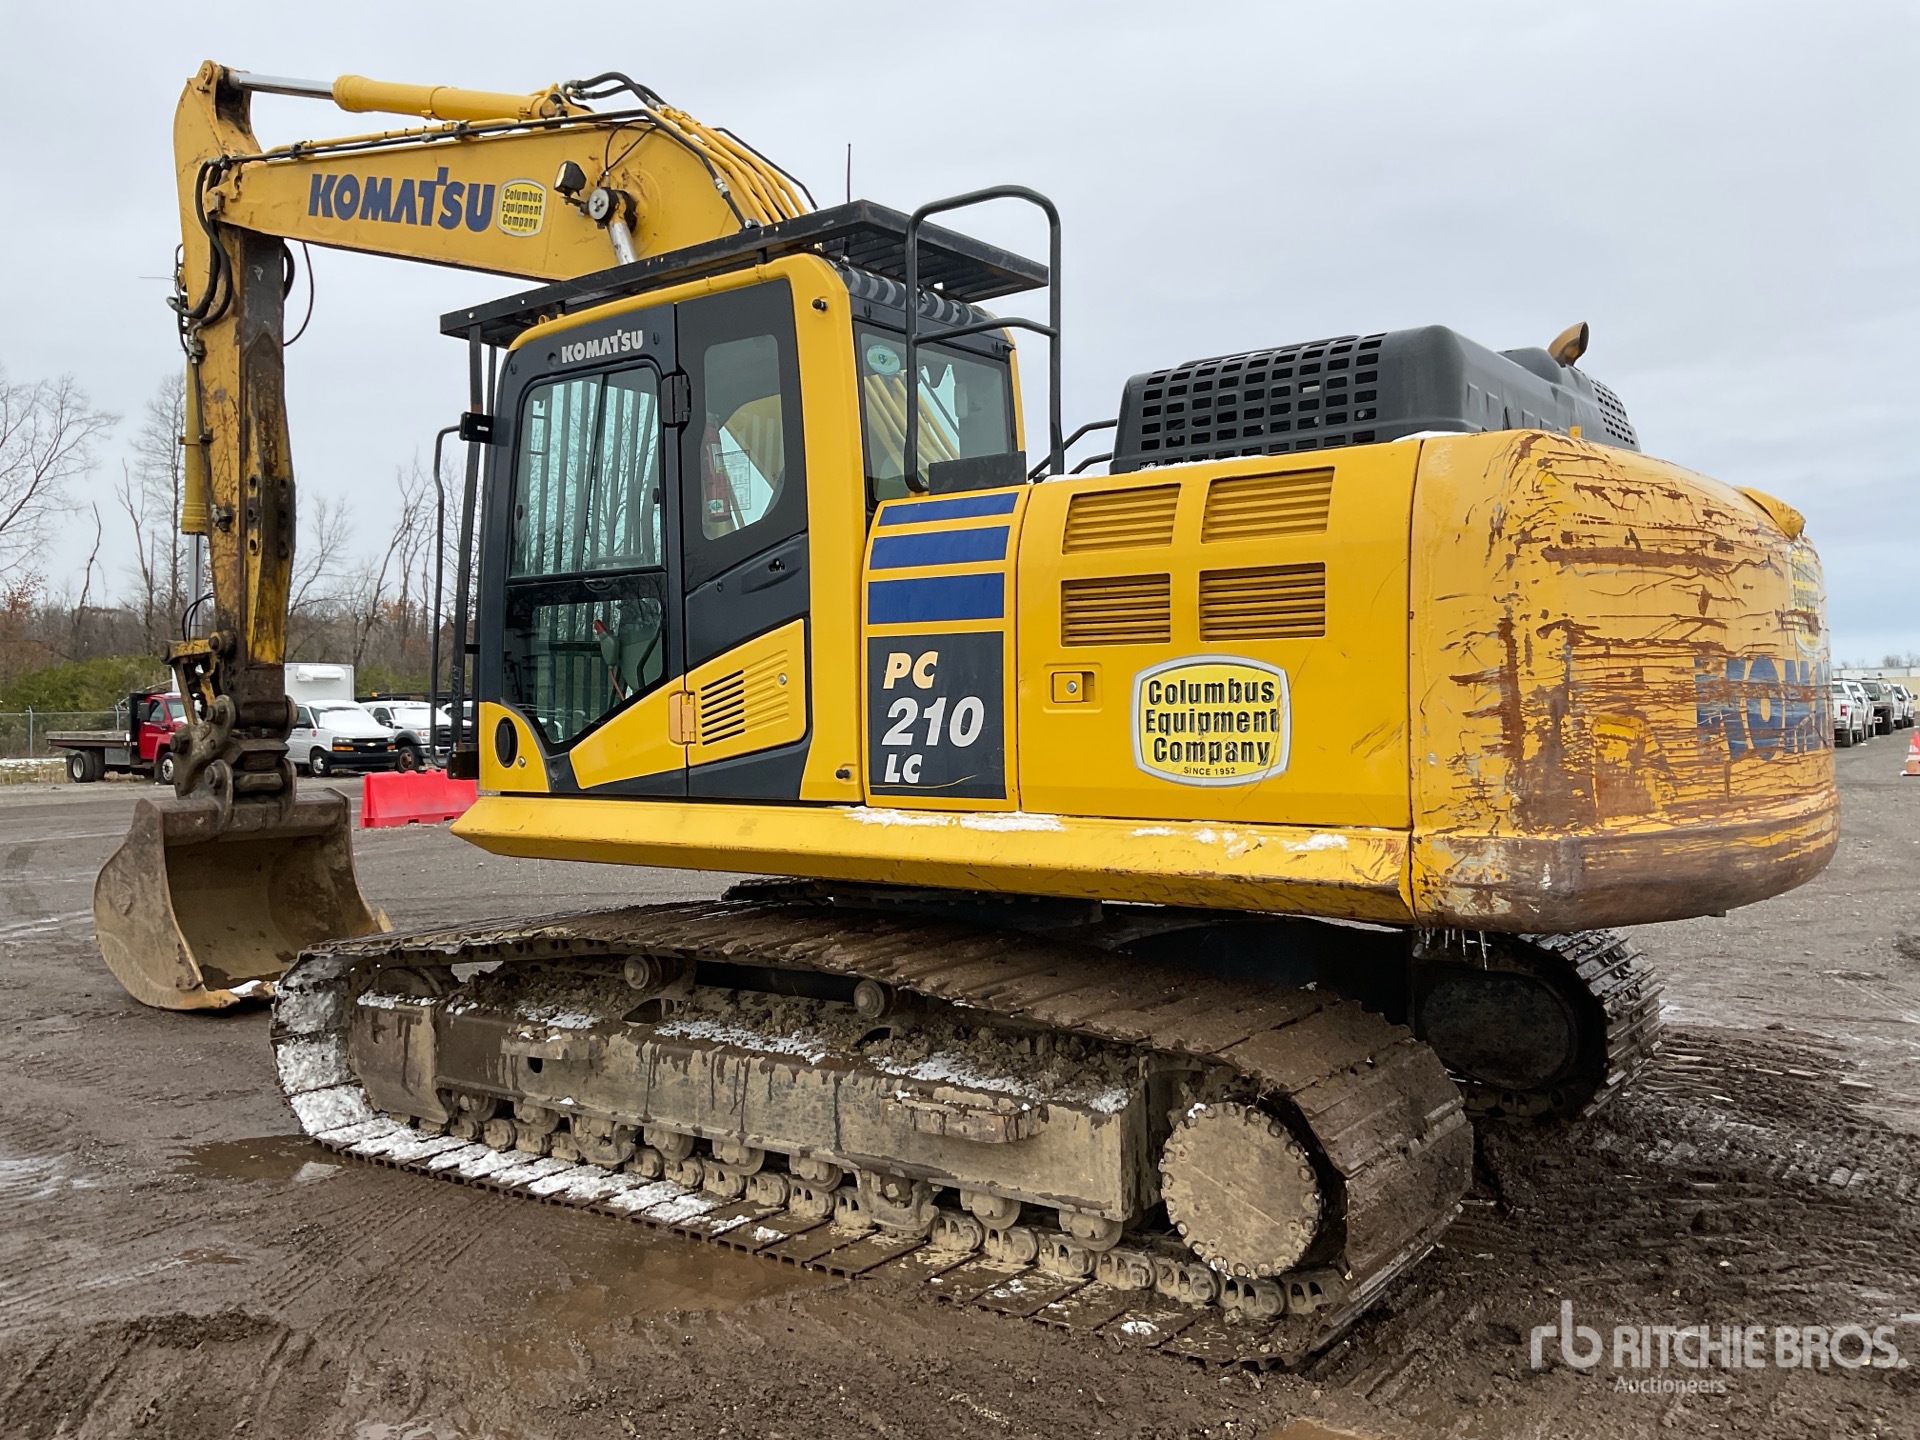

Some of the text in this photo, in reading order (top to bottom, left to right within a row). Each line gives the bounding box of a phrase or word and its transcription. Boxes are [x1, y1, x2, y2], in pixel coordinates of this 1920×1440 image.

[308, 167, 495, 232] KOMATSU
[502, 200, 542, 215] Equipment
[504, 188, 542, 203] Columbus
[503, 213, 538, 229] Company
[561, 329, 643, 363] KOMATSU
[882, 651, 939, 689] PC
[1148, 678, 1275, 705] Columbus
[881, 696, 985, 748] 210
[1146, 708, 1280, 736] Equipment
[1153, 737, 1270, 766] Company
[884, 754, 923, 784] LC
[1183, 766, 1236, 776] SINCE 1952
